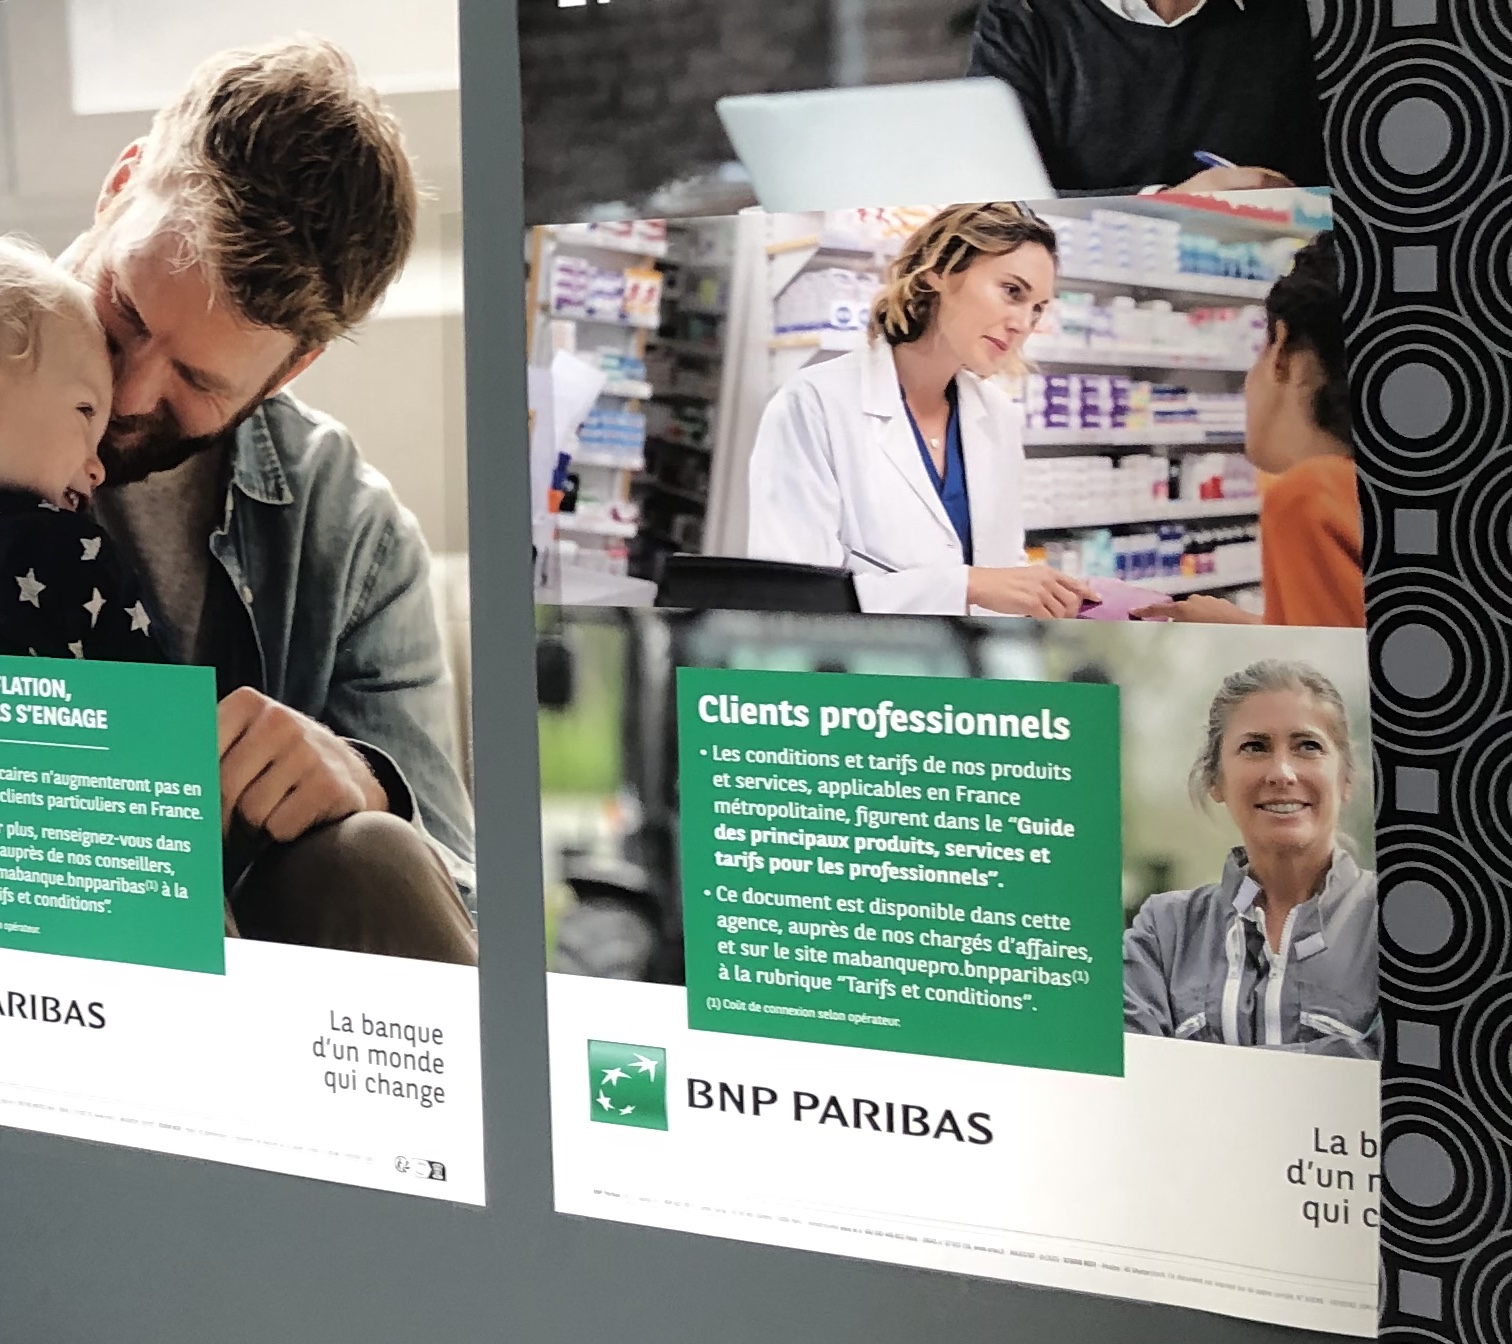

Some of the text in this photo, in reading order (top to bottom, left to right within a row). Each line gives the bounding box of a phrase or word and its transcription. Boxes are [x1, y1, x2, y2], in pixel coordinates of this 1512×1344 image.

[15, 703, 108, 729] S'ENGAGE
[697, 694, 1070, 740] Clients professionnels
[712, 744, 1071, 781] Les conditions et tarifs de nos produits
[40, 769, 152, 793] n'augmenteront
[153, 781, 180, 797] pas
[182, 783, 202, 796] en
[712, 772, 1021, 806] et services, applicables en France
[46, 794, 126, 814] particuliers
[128, 802, 147, 815] en
[150, 800, 203, 820] France.
[713, 797, 1075, 837] métropolitaine, figurent dans le "Guide
[6, 820, 38, 840] plus,
[41, 827, 153, 849] renseignez-vous
[155, 834, 191, 853] dans
[713, 822, 1051, 864] des principaux produits, services et
[46, 847, 64, 863] de
[66, 852, 92, 866] nos
[94, 855, 175, 876] conseillers,
[713, 850, 1004, 888] tarifs pour les professionnels".
[16, 890, 32, 905] et
[160, 880, 171, 897] à
[173, 882, 189, 899] la
[715, 884, 1071, 931] Ce document est disponible dans cette
[716, 914, 1093, 963] agence, auprès de nos chargés d'affaires,
[717, 939, 736, 955] et
[739, 942, 769, 958] sur
[773, 941, 790, 960] le
[793, 944, 828, 963] site
[717, 962, 1037, 1011] à la rubrique "Tarifs et conditions".
[330, 1009, 443, 1047] La banque
[705, 996, 901, 1027] (1) Coût de connexion selon opérateur.
[312, 1035, 444, 1075] d'un monde
[324, 1069, 445, 1109] qui change
[687, 1077, 993, 1145] BNP PARIBAS
[1314, 1127, 1348, 1155] La
[1287, 1158, 1354, 1190] d'un
[1303, 1199, 1349, 1228] qui
